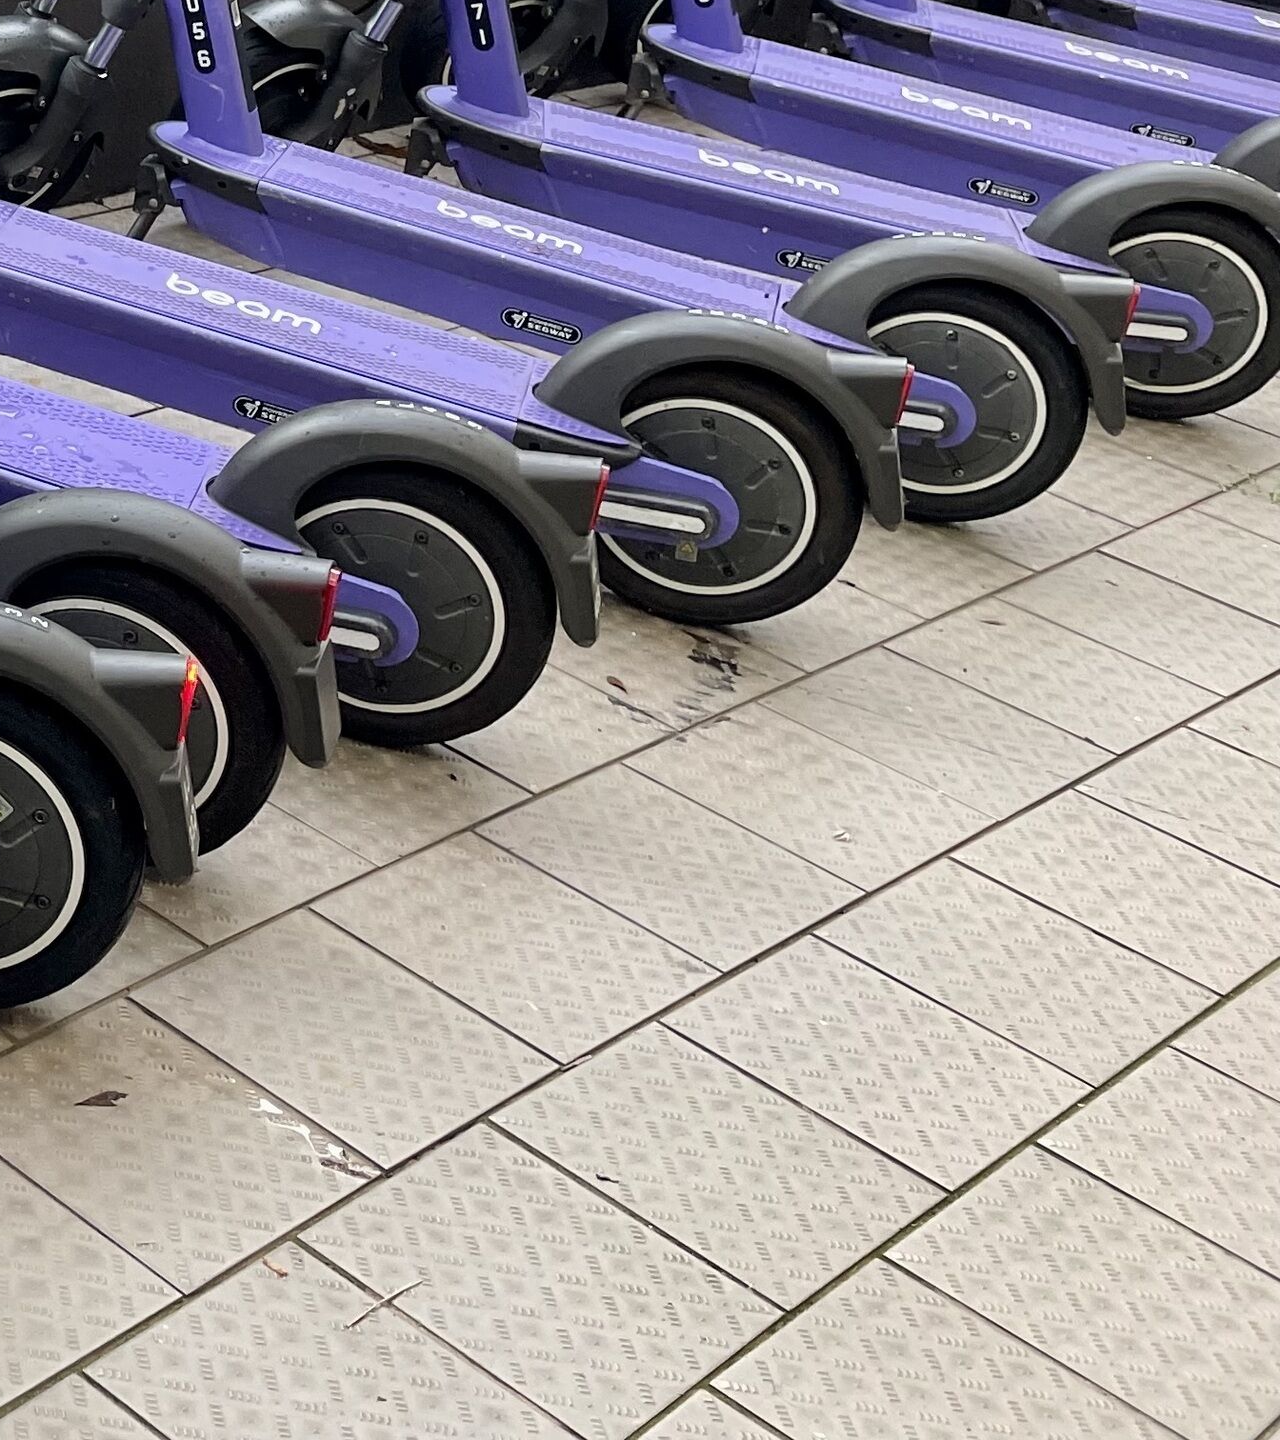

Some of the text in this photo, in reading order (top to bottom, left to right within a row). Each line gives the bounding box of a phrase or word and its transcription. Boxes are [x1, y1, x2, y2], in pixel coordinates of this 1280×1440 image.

[1065, 41, 1189, 80] beam
[902, 86, 1032, 130] beam
[698, 148, 840, 196] beam
[436, 200, 583, 255] beam
[166, 272, 323, 335] beam
[527, 322, 572, 339] SEGWAY
